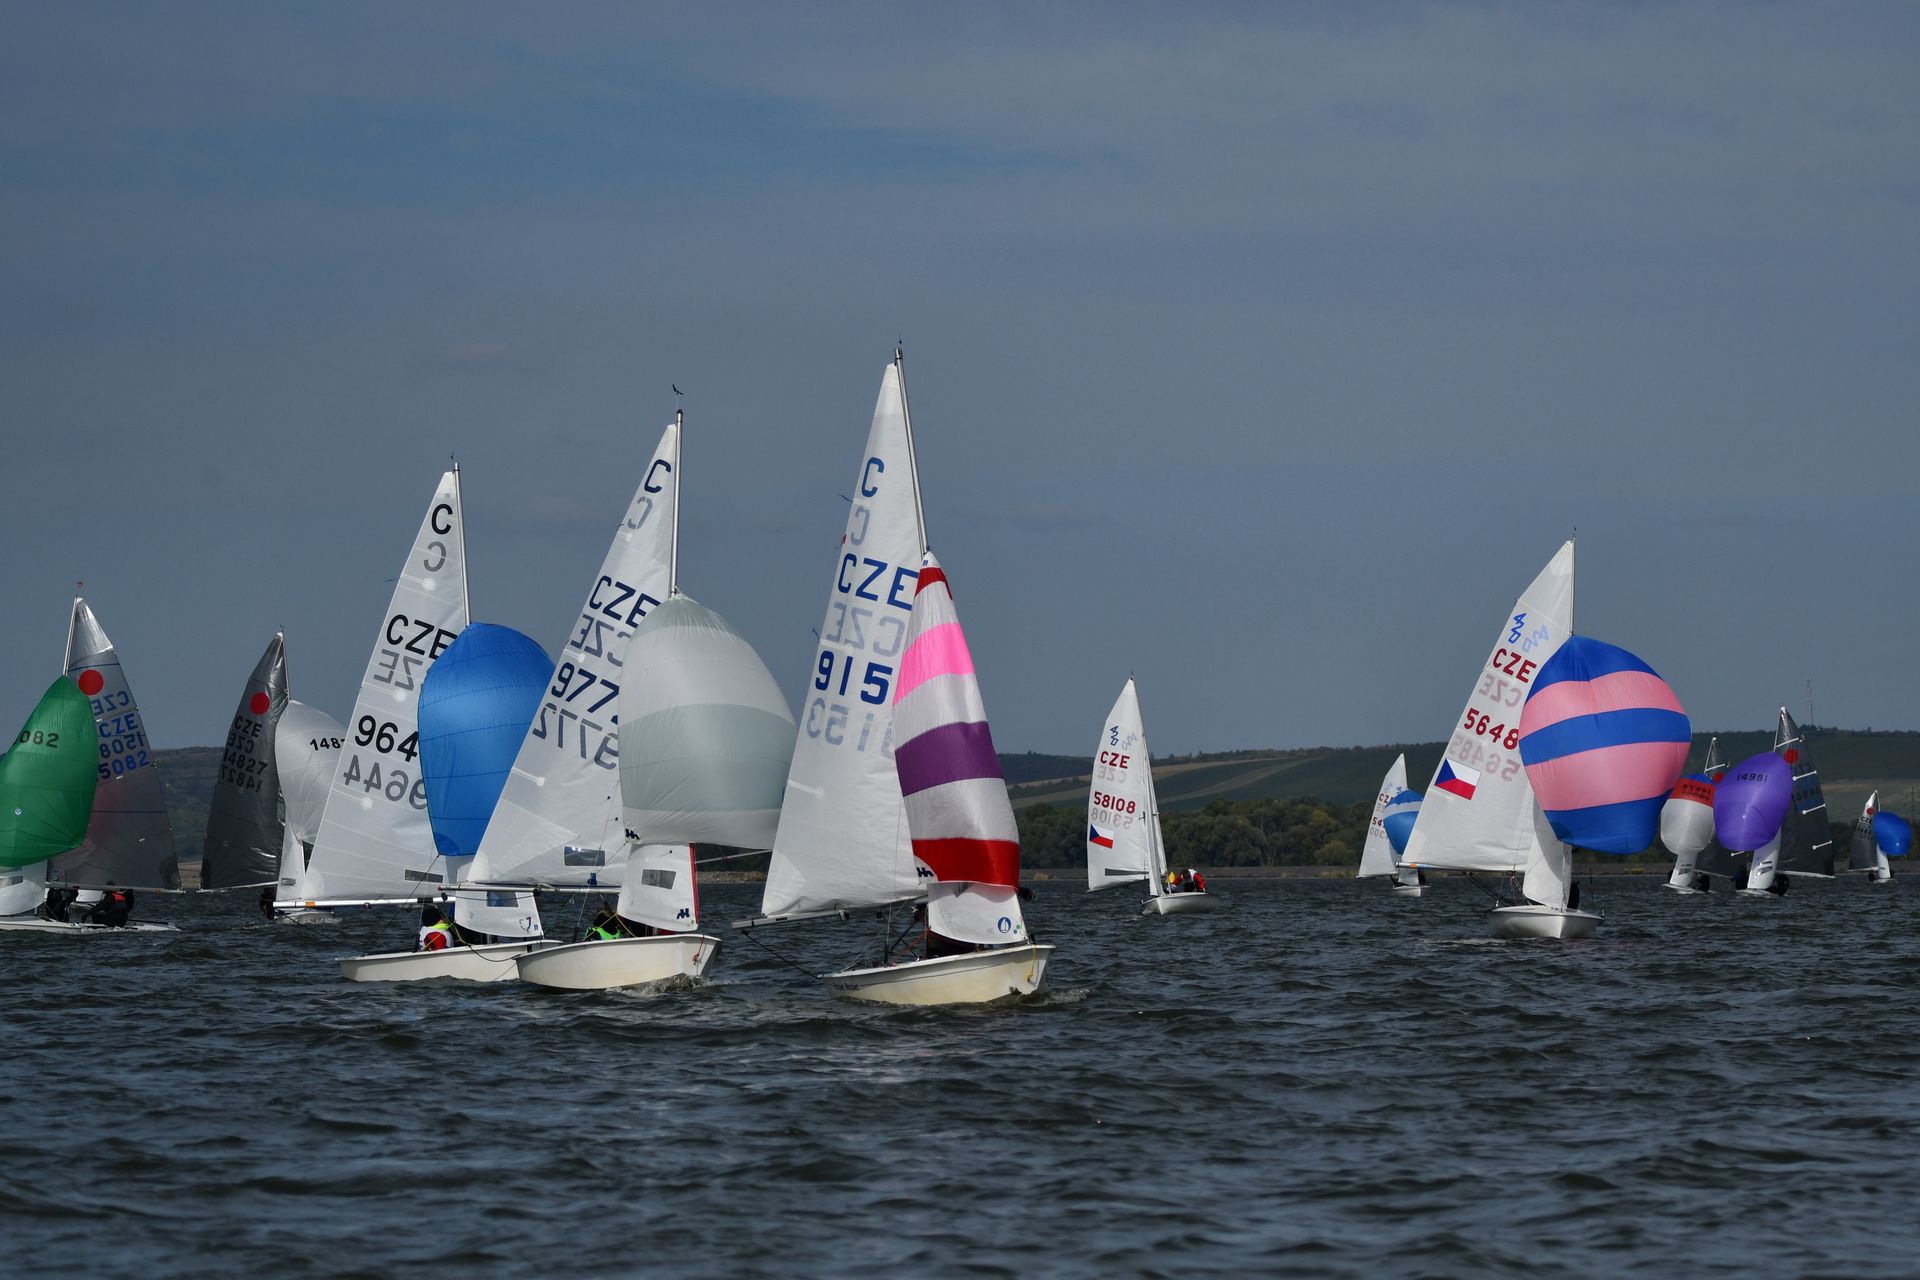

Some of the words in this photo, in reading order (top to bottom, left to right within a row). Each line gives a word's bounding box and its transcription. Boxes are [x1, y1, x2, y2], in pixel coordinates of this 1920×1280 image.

[644, 459, 671, 494] C
[861, 457, 885, 498] C
[431, 503, 453, 534] C
[837, 553, 919, 612] CZE
[589, 575, 661, 628] CZE
[386, 614, 458, 660] CZE
[815, 651, 893, 705] 915
[1493, 647, 1537, 684] CZE
[551, 662, 619, 725] 977
[99, 713, 138, 738] CZE
[235, 716, 263, 738] CZE
[1464, 707, 1519, 750] 5648
[223, 749, 268, 775] 14827
[310, 737, 346, 751] 148
[1100, 751, 1130, 769] CZE
[1379, 793, 1393, 804] CZ
